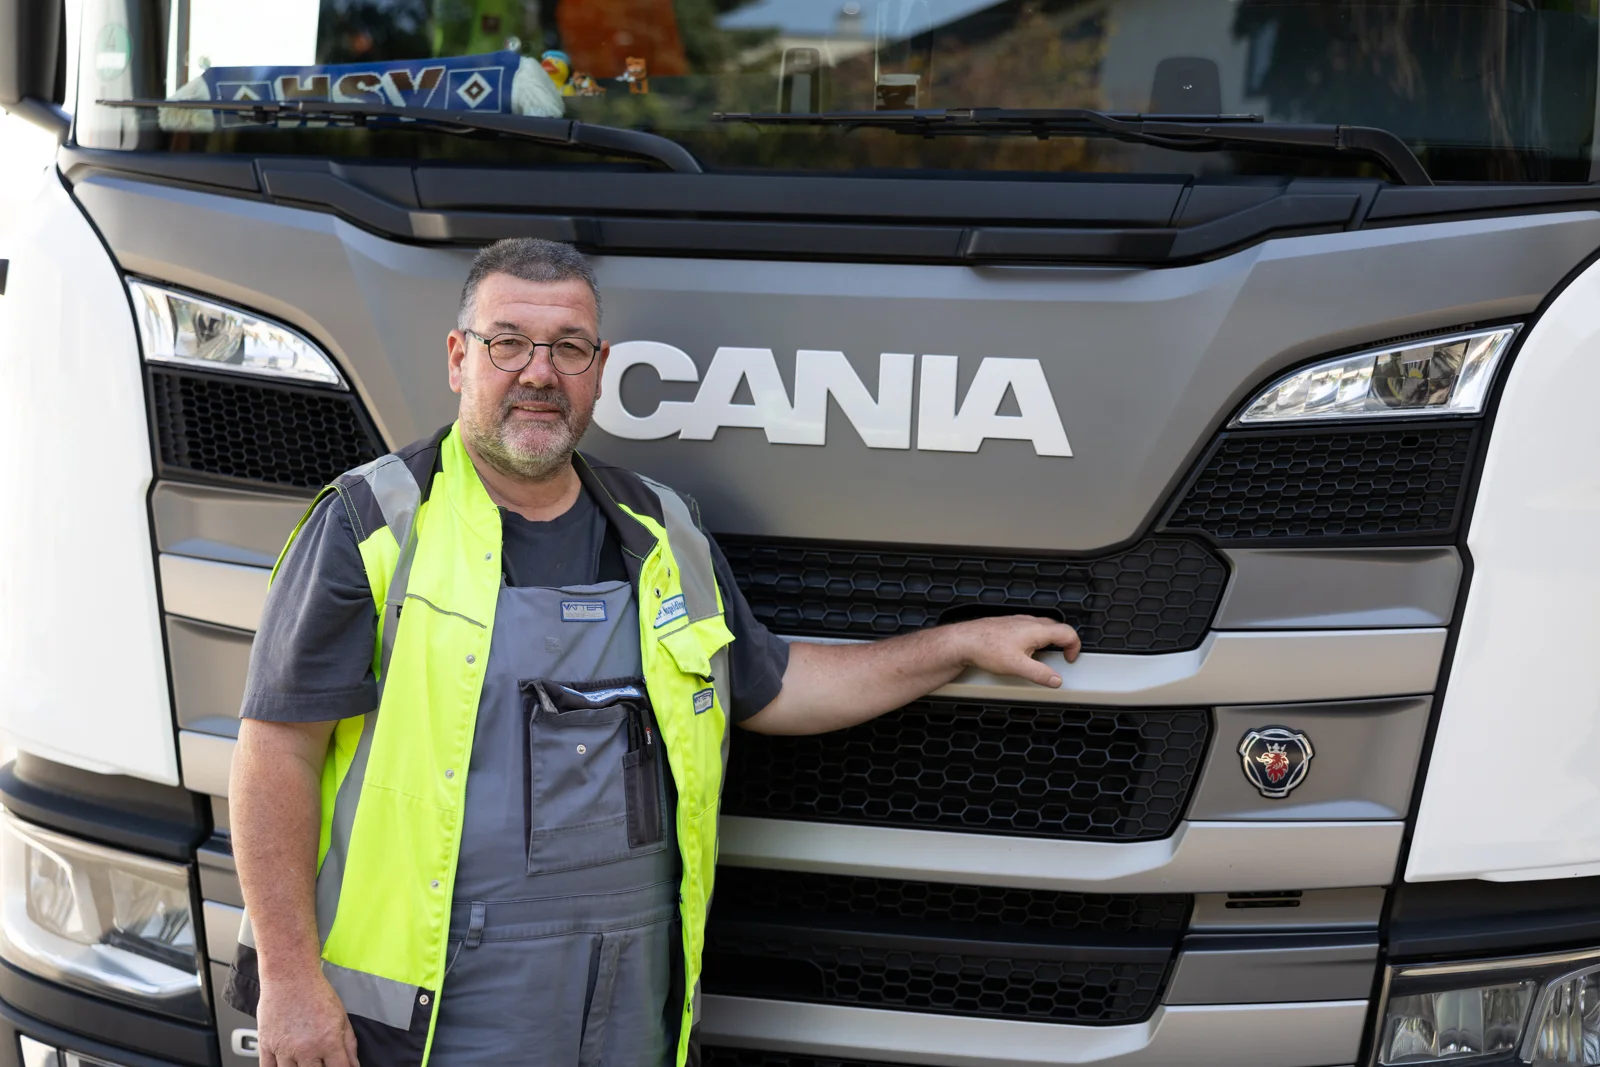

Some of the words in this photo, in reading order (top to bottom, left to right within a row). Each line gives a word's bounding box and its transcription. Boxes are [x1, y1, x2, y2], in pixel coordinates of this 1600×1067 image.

[274, 66, 446, 128] HSV
[593, 340, 1074, 458] CANIA
[563, 603, 604, 611] VATTER
